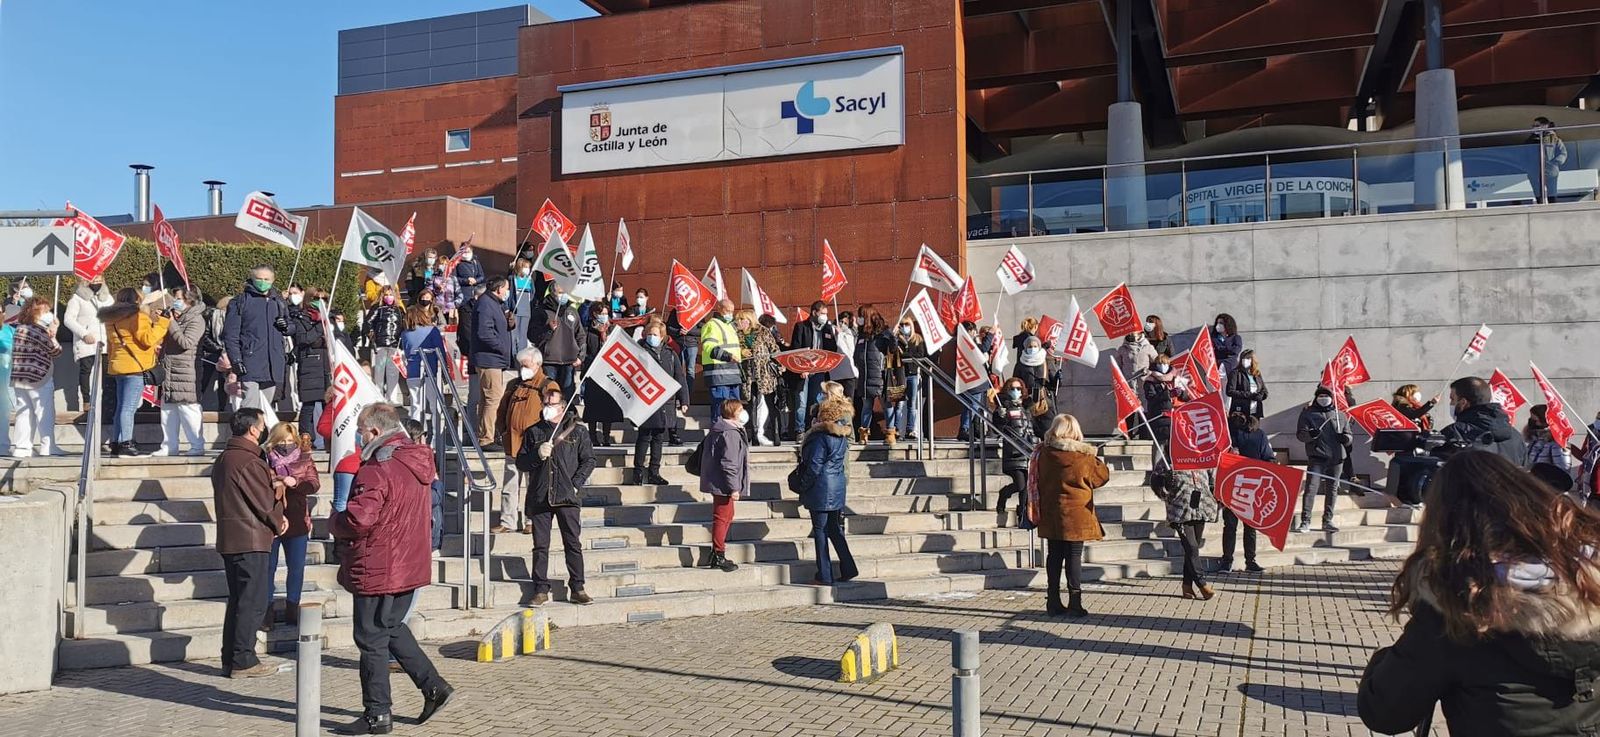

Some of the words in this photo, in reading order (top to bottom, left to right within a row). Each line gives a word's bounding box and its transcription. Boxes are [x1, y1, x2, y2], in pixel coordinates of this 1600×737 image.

[835, 92, 886, 116] Sacyl
[615, 126, 649, 137] Junta
[652, 123, 667, 133] de
[584, 140, 624, 153] Castilla
[628, 141, 635, 152] y
[639, 136, 668, 148] León
[1276, 181, 1294, 192] DE
[1299, 181, 1313, 191] LA
[250, 202, 293, 231] CCOO
[1067, 313, 1088, 353] CCO
[606, 372, 632, 400] Zamora
[608, 347, 660, 400] CCOO
[1188, 407, 1217, 446] UGT
[1230, 474, 1263, 521] UGT
